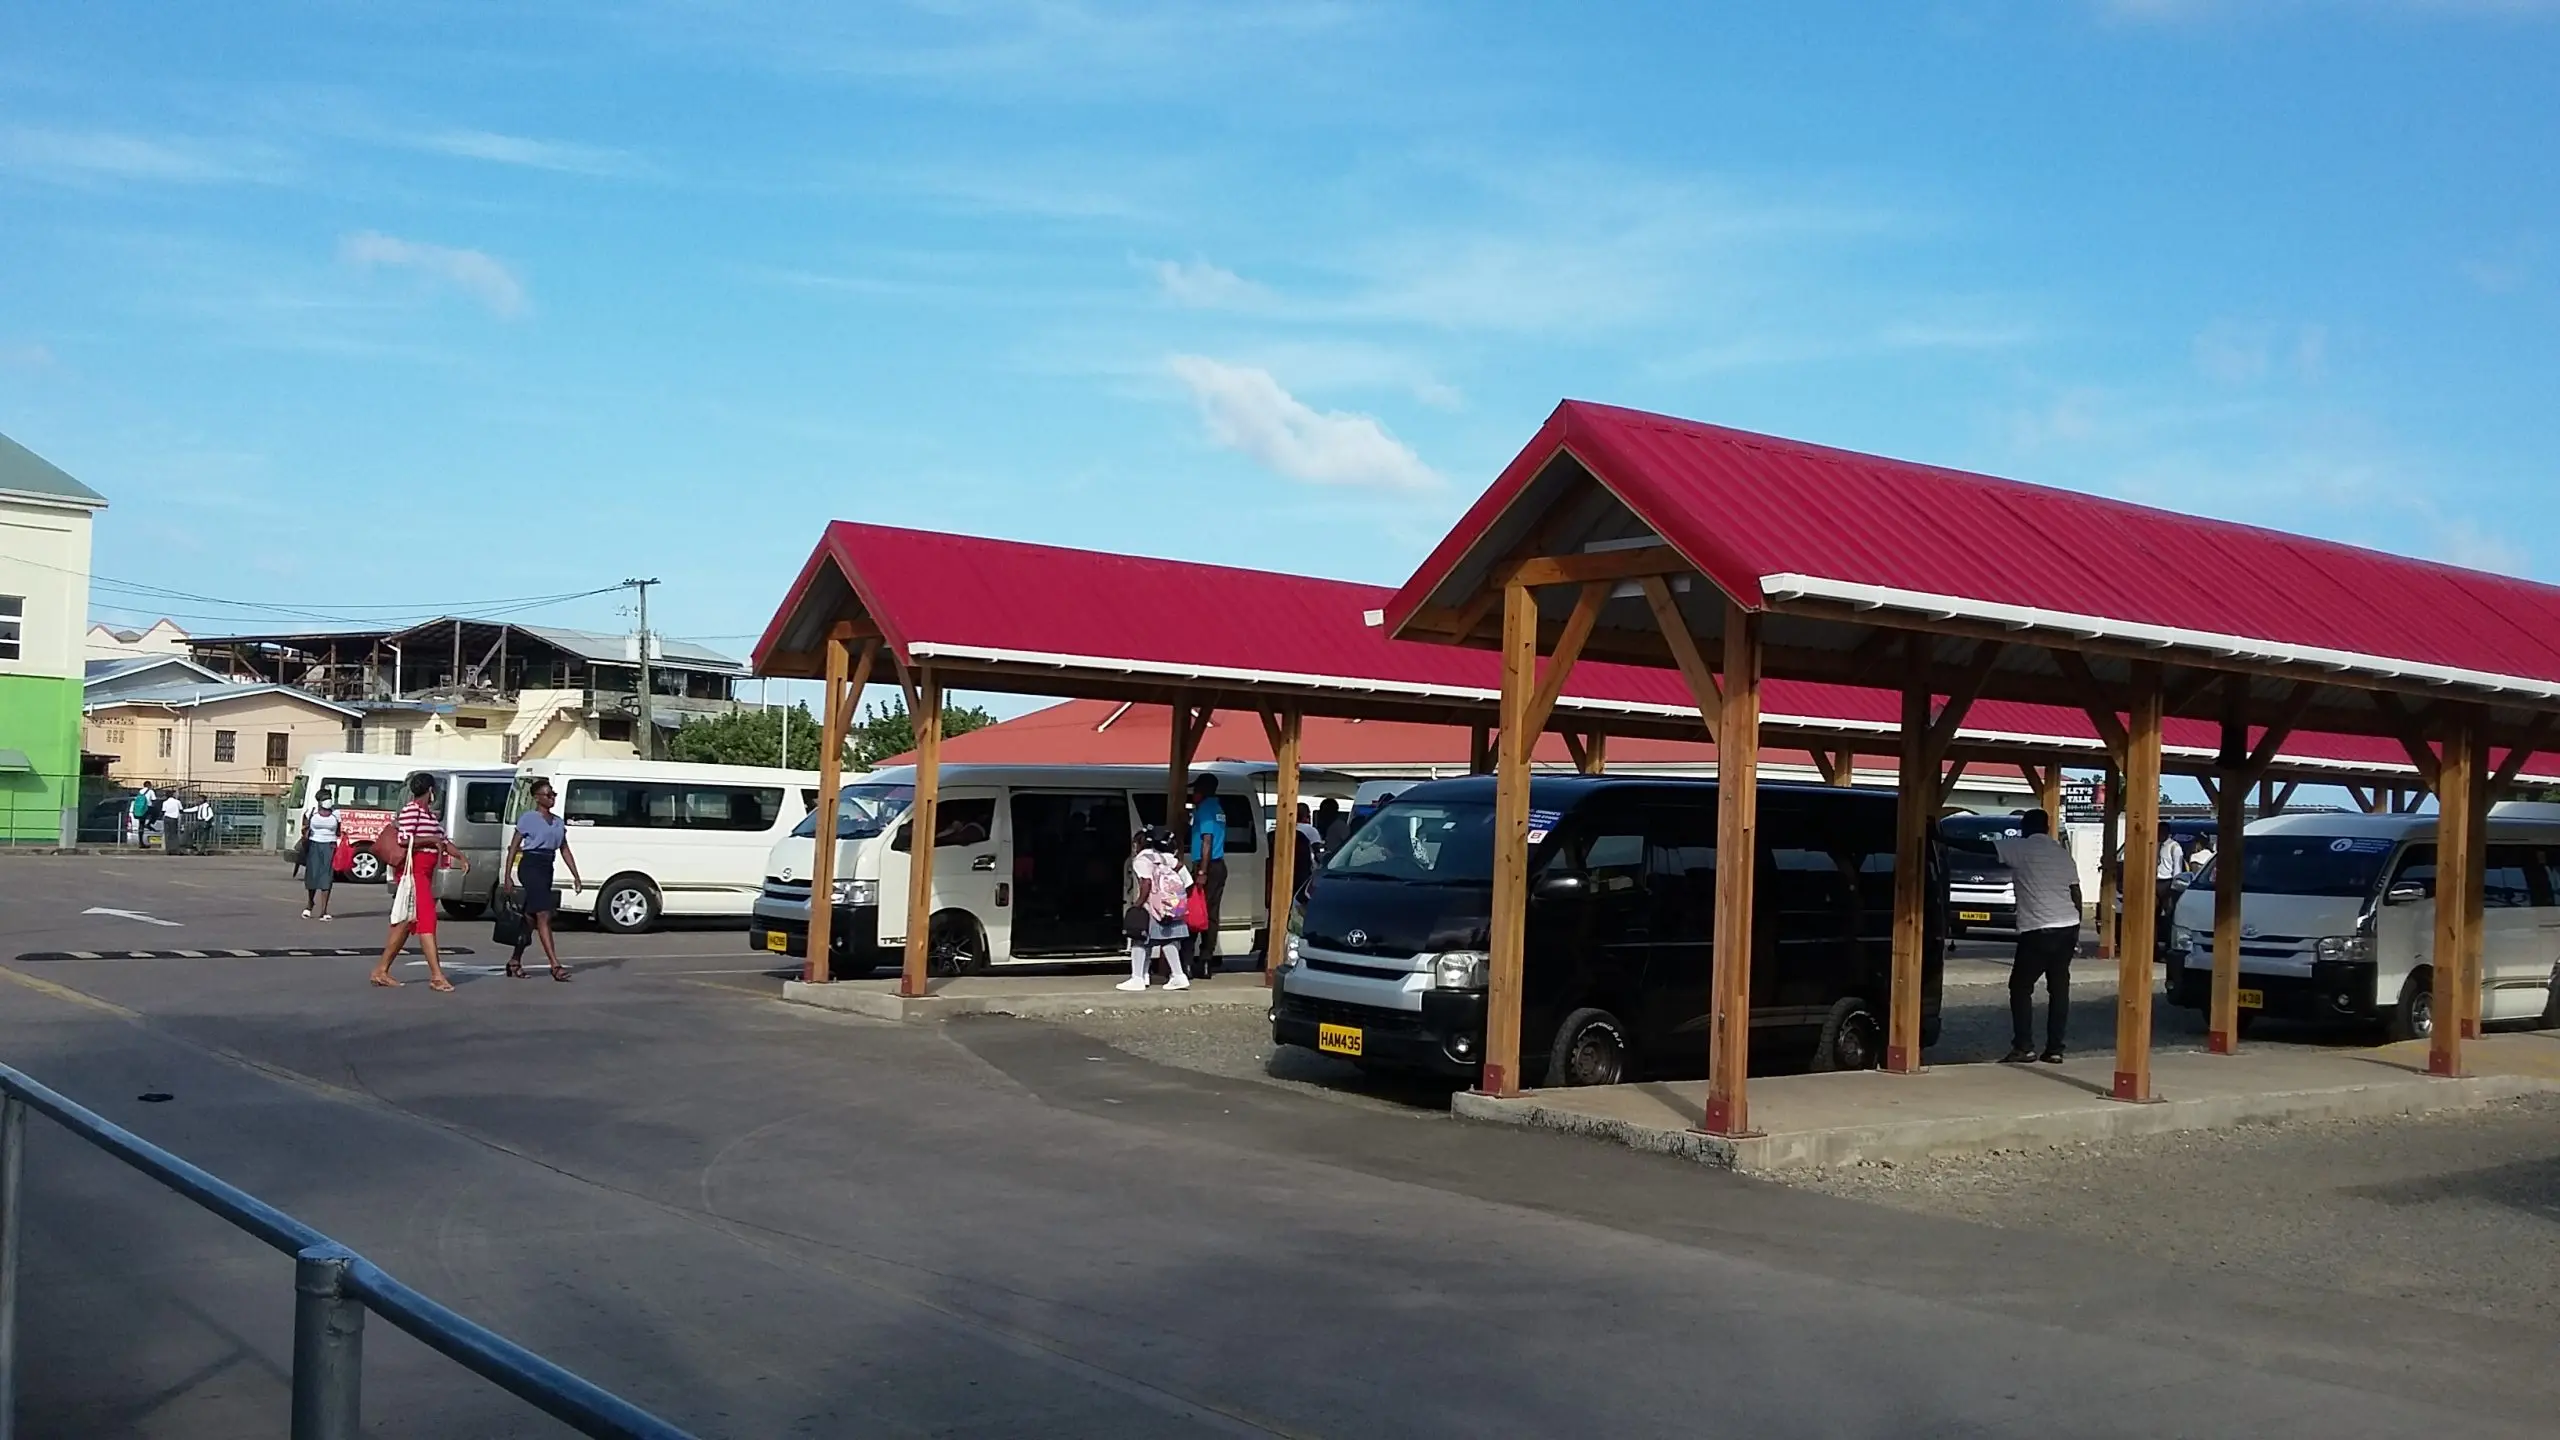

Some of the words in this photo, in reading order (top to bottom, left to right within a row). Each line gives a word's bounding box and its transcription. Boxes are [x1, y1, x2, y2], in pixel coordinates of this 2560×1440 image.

[2067, 787, 2093, 795] LET'S
[355, 812, 385, 820] FINANCE
[1321, 1031, 1361, 1051] HAM435
